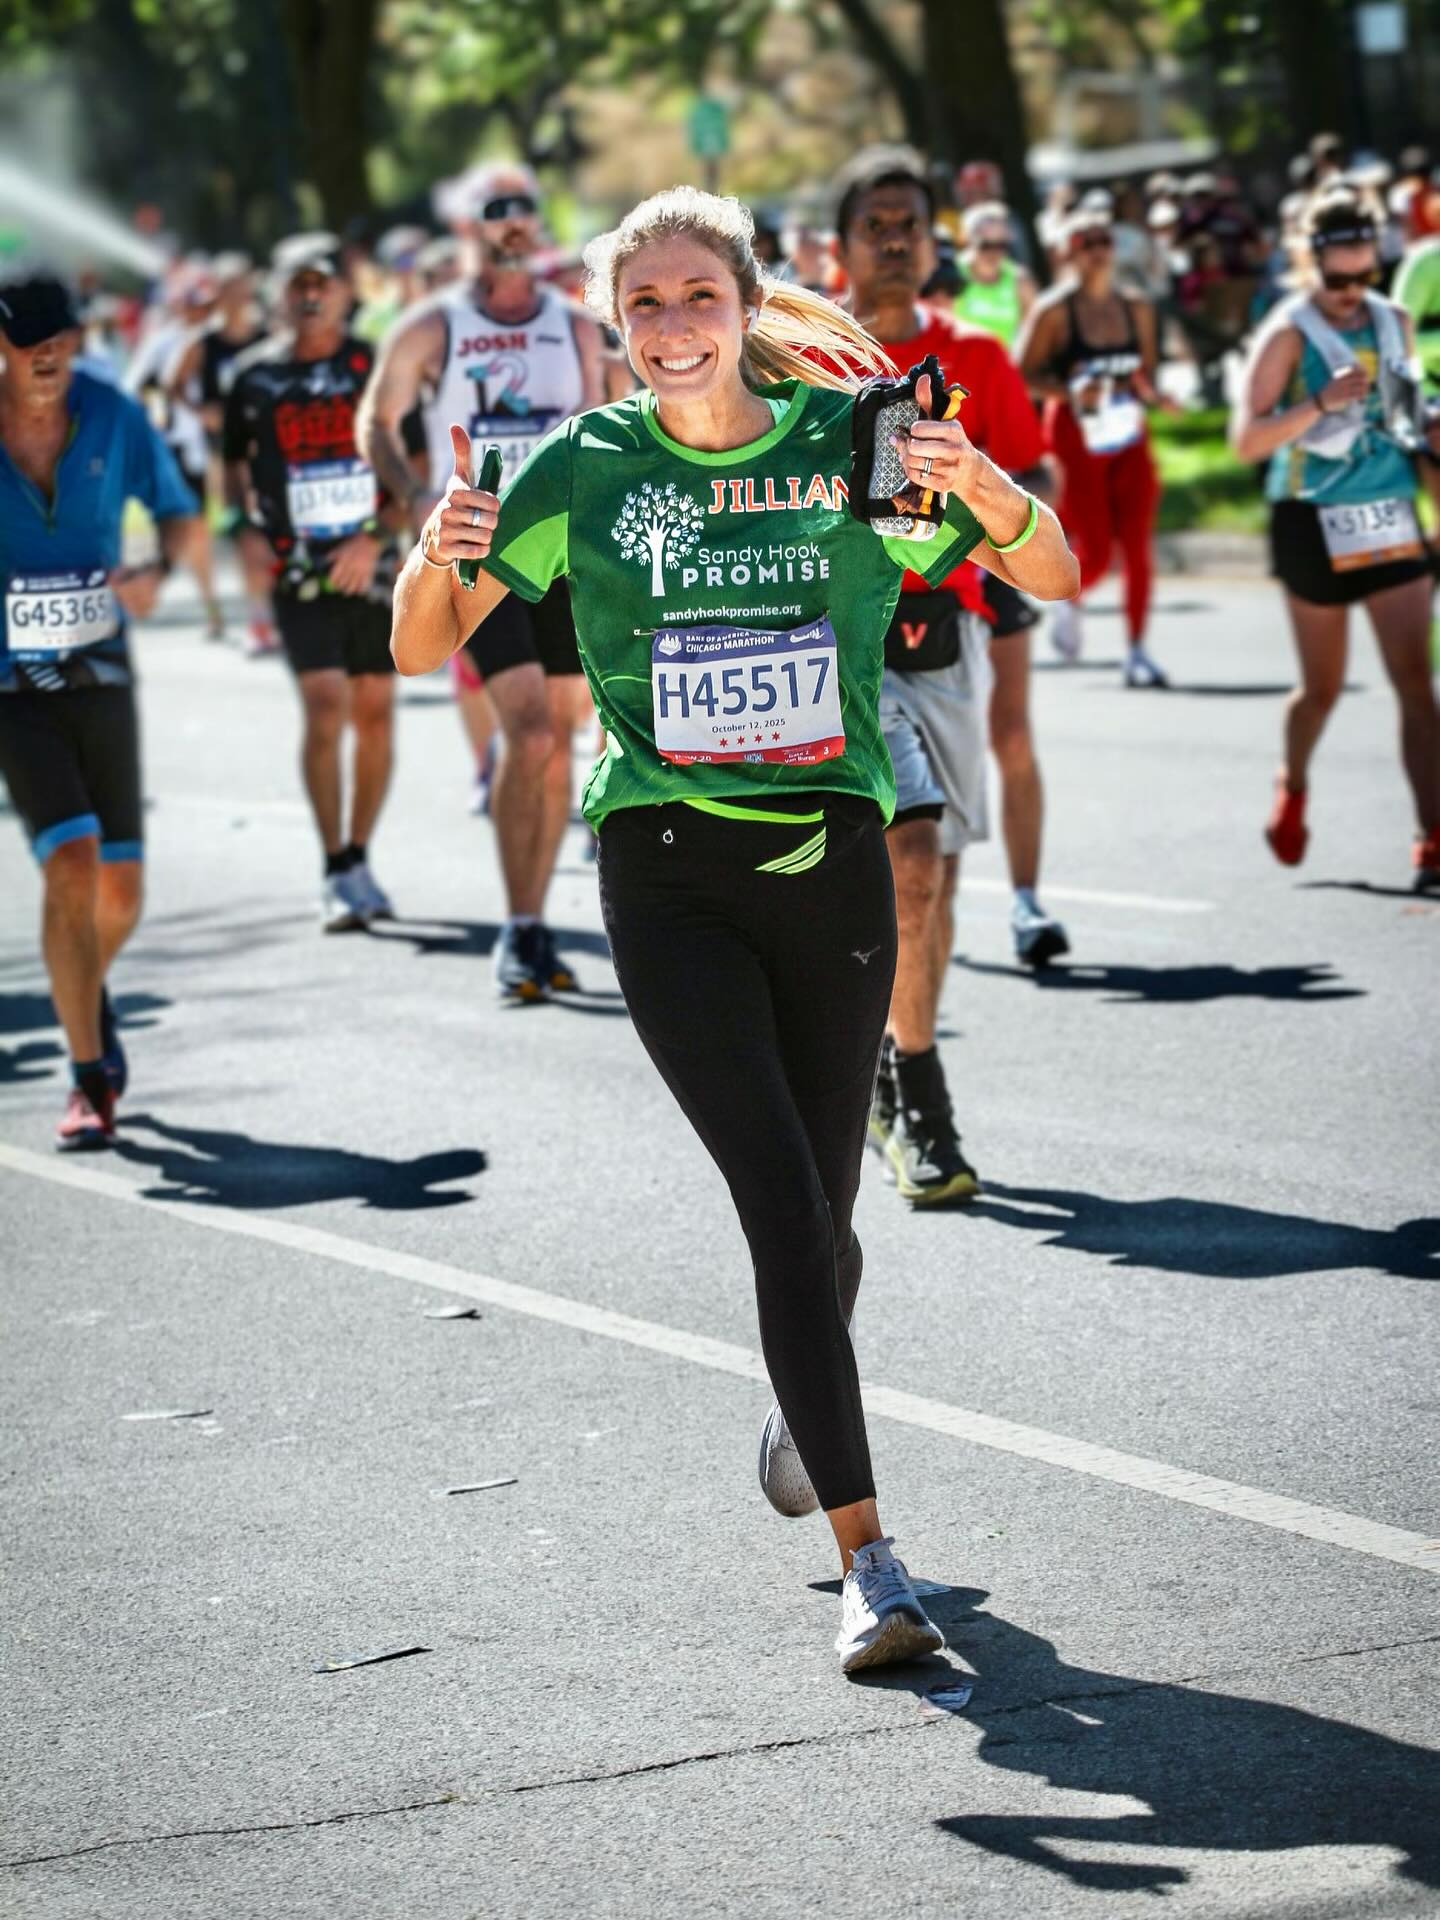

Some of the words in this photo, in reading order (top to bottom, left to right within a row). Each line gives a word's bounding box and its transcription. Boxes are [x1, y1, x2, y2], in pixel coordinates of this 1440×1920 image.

[456, 332, 527, 357] JOSH
[698, 546, 763, 565] Sandy
[769, 542, 821, 561] Hook
[682, 558, 829, 588] PROMISE
[662, 604, 802, 621] sandyhookpromise.org
[686, 643, 721, 653] CHICAGO
[723, 635, 775, 650] MARATHON
[658, 656, 830, 718] H45517
[711, 724, 746, 734] October
[749, 721, 762, 729] 12,
[764, 718, 786, 728] 2025
[823, 746, 829, 755] 3
